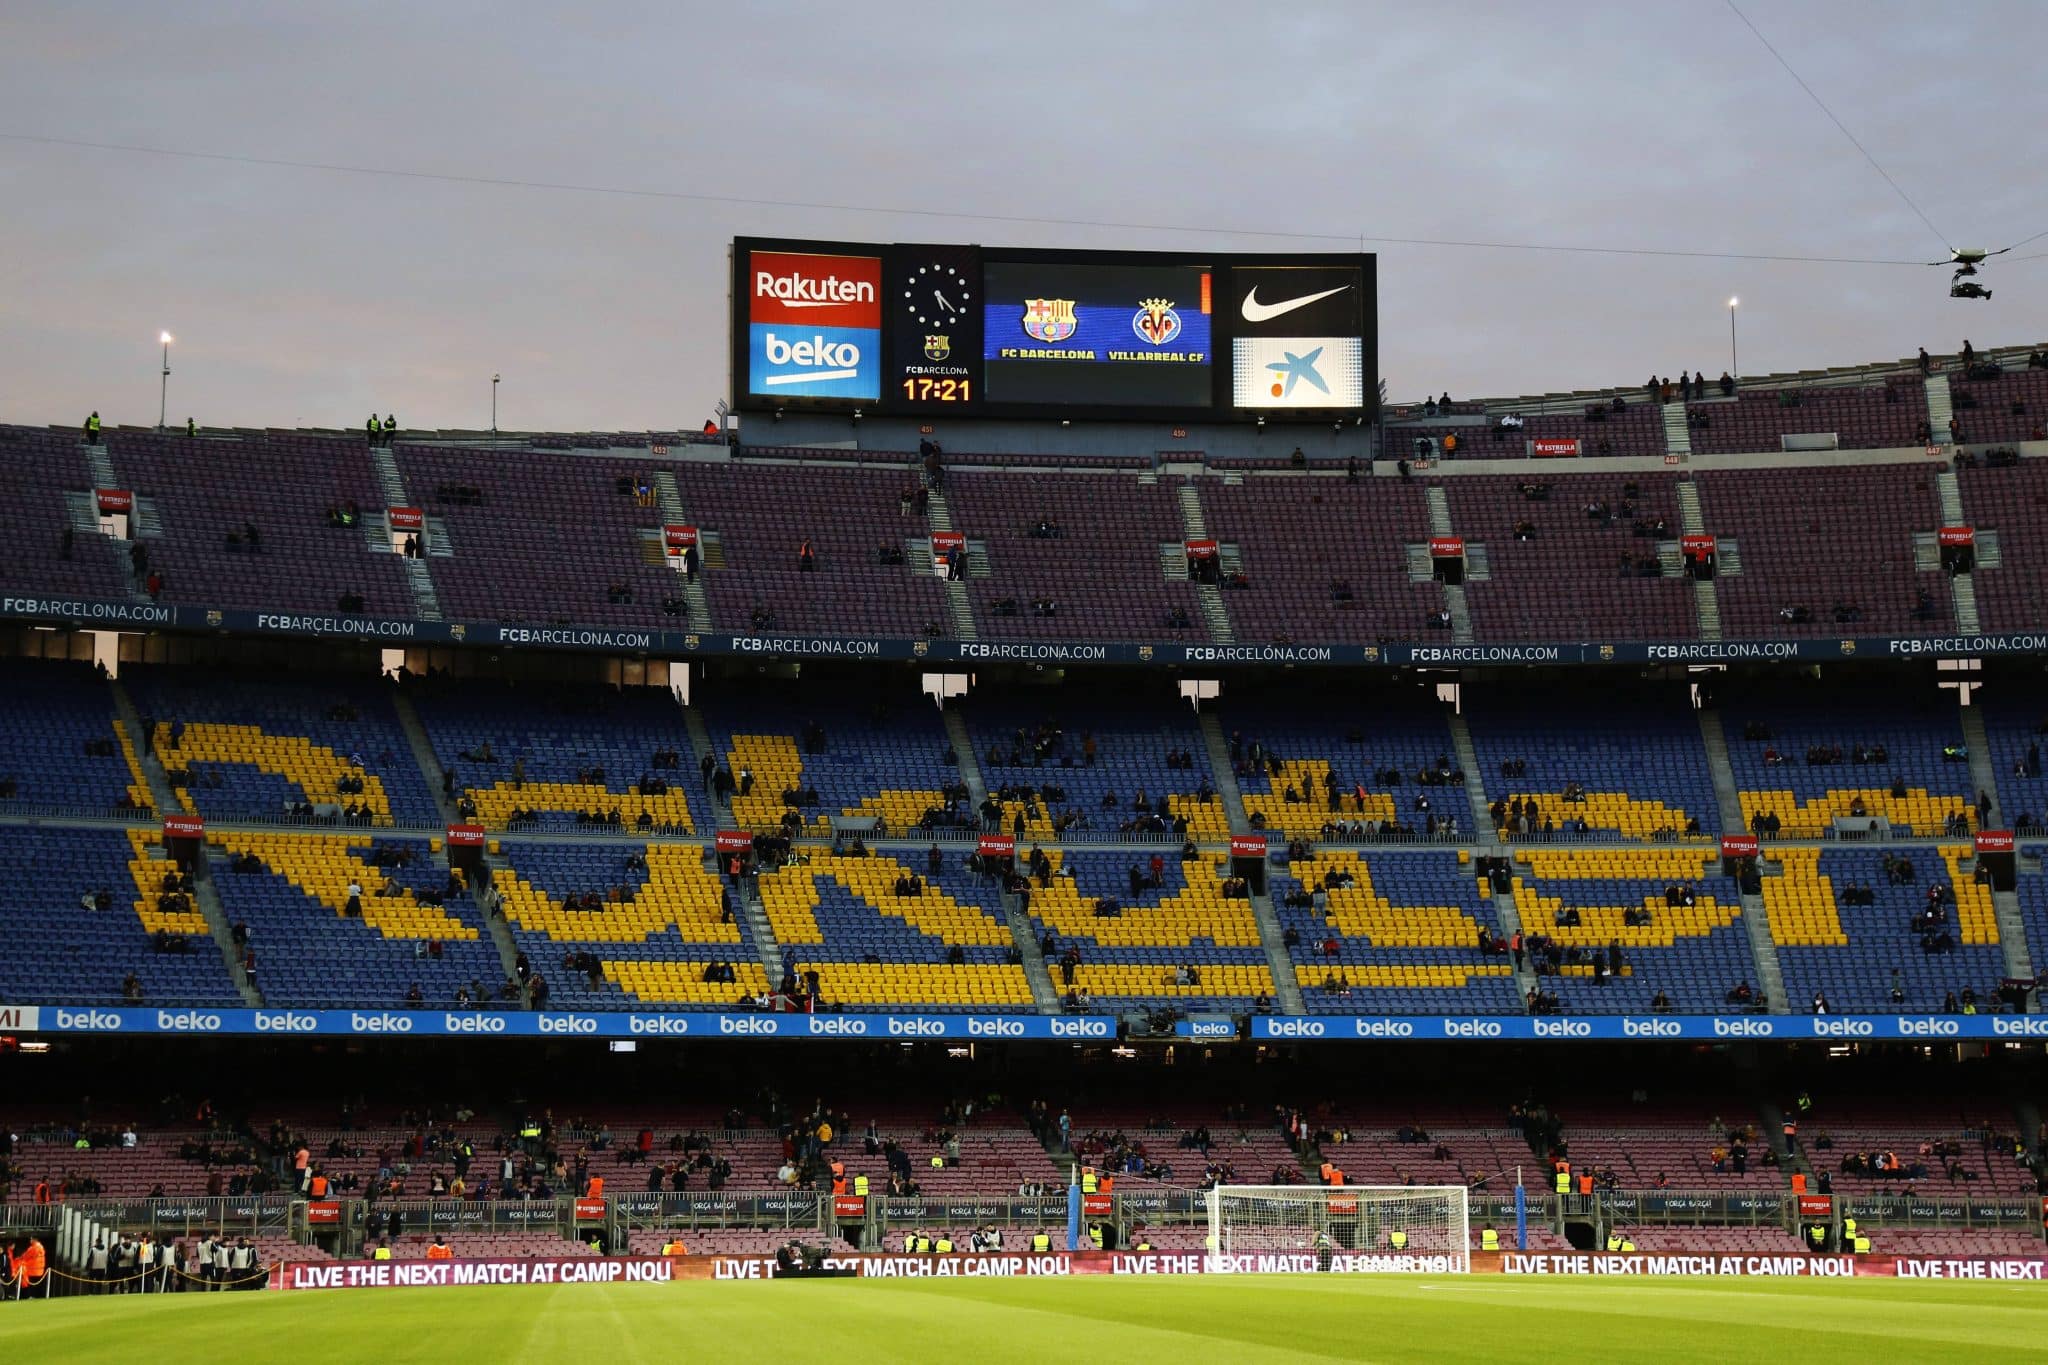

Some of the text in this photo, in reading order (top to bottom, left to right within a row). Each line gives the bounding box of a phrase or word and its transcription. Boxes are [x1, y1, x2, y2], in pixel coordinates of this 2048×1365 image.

[757, 271, 874, 303] Rakuten
[766, 333, 860, 368] beko
[1001, 348, 1095, 360] FC BARCELONA
[1108, 351, 1204, 362] VILLARREAL CF
[906, 366, 969, 375] FCBARCELONA
[903, 379, 969, 401] 17:21
[4, 596, 168, 621] FCBARCELONA.COM
[259, 615, 413, 636] FCBARCELONA.COM
[500, 629, 648, 647] FCBARCELONA.COM
[733, 638, 878, 653] FCBARCELONA.COM
[1891, 633, 2046, 652] FCBARCELONA.COM
[960, 640, 1104, 660] FCBARCELONA.COM
[1186, 644, 1330, 659] FCBARCELONA.COM
[1412, 644, 1557, 660] FCBARCELONA.COM
[1648, 643, 1797, 657] FCBARCELONA.COM
[57, 1010, 121, 1029] beko
[158, 1011, 220, 1030] beko
[255, 1012, 316, 1030] beko
[352, 1013, 412, 1031] beko
[446, 1014, 505, 1031] beko
[539, 1015, 597, 1032] beko
[630, 1016, 687, 1033] beko
[721, 1016, 777, 1033] beko
[810, 1016, 866, 1034] beko
[889, 1018, 944, 1034] beko
[969, 1018, 1024, 1035] beko
[1051, 1018, 1106, 1035] beko
[1269, 1019, 1324, 1035] beko
[1357, 1019, 1412, 1036] beko
[1445, 1019, 1501, 1036] beko
[1534, 1019, 1590, 1036] beko
[1624, 1019, 1681, 1035] beko
[1714, 1019, 1772, 1035] beko
[1814, 1018, 1872, 1035] beko
[1899, 1017, 1958, 1034] beko
[1193, 1023, 1228, 1034] beko
[715, 1259, 761, 1279] LIVE
[863, 1258, 933, 1277] MATCH
[936, 1258, 960, 1277] AT
[964, 1257, 1022, 1276] CAMP
[1027, 1256, 1070, 1275] NOU
[1113, 1255, 1157, 1274] LIVE
[1160, 1255, 1199, 1274] THE
[1203, 1255, 1255, 1273] NEXT
[1504, 1255, 1853, 1276] LIVE THE NEXT MATCH AT CAMP NOU
[1896, 1259, 2044, 1280] LIVE THE NEXT
[295, 1260, 671, 1287] LIVE THE NEXT MATCH AT CAMP NOU
